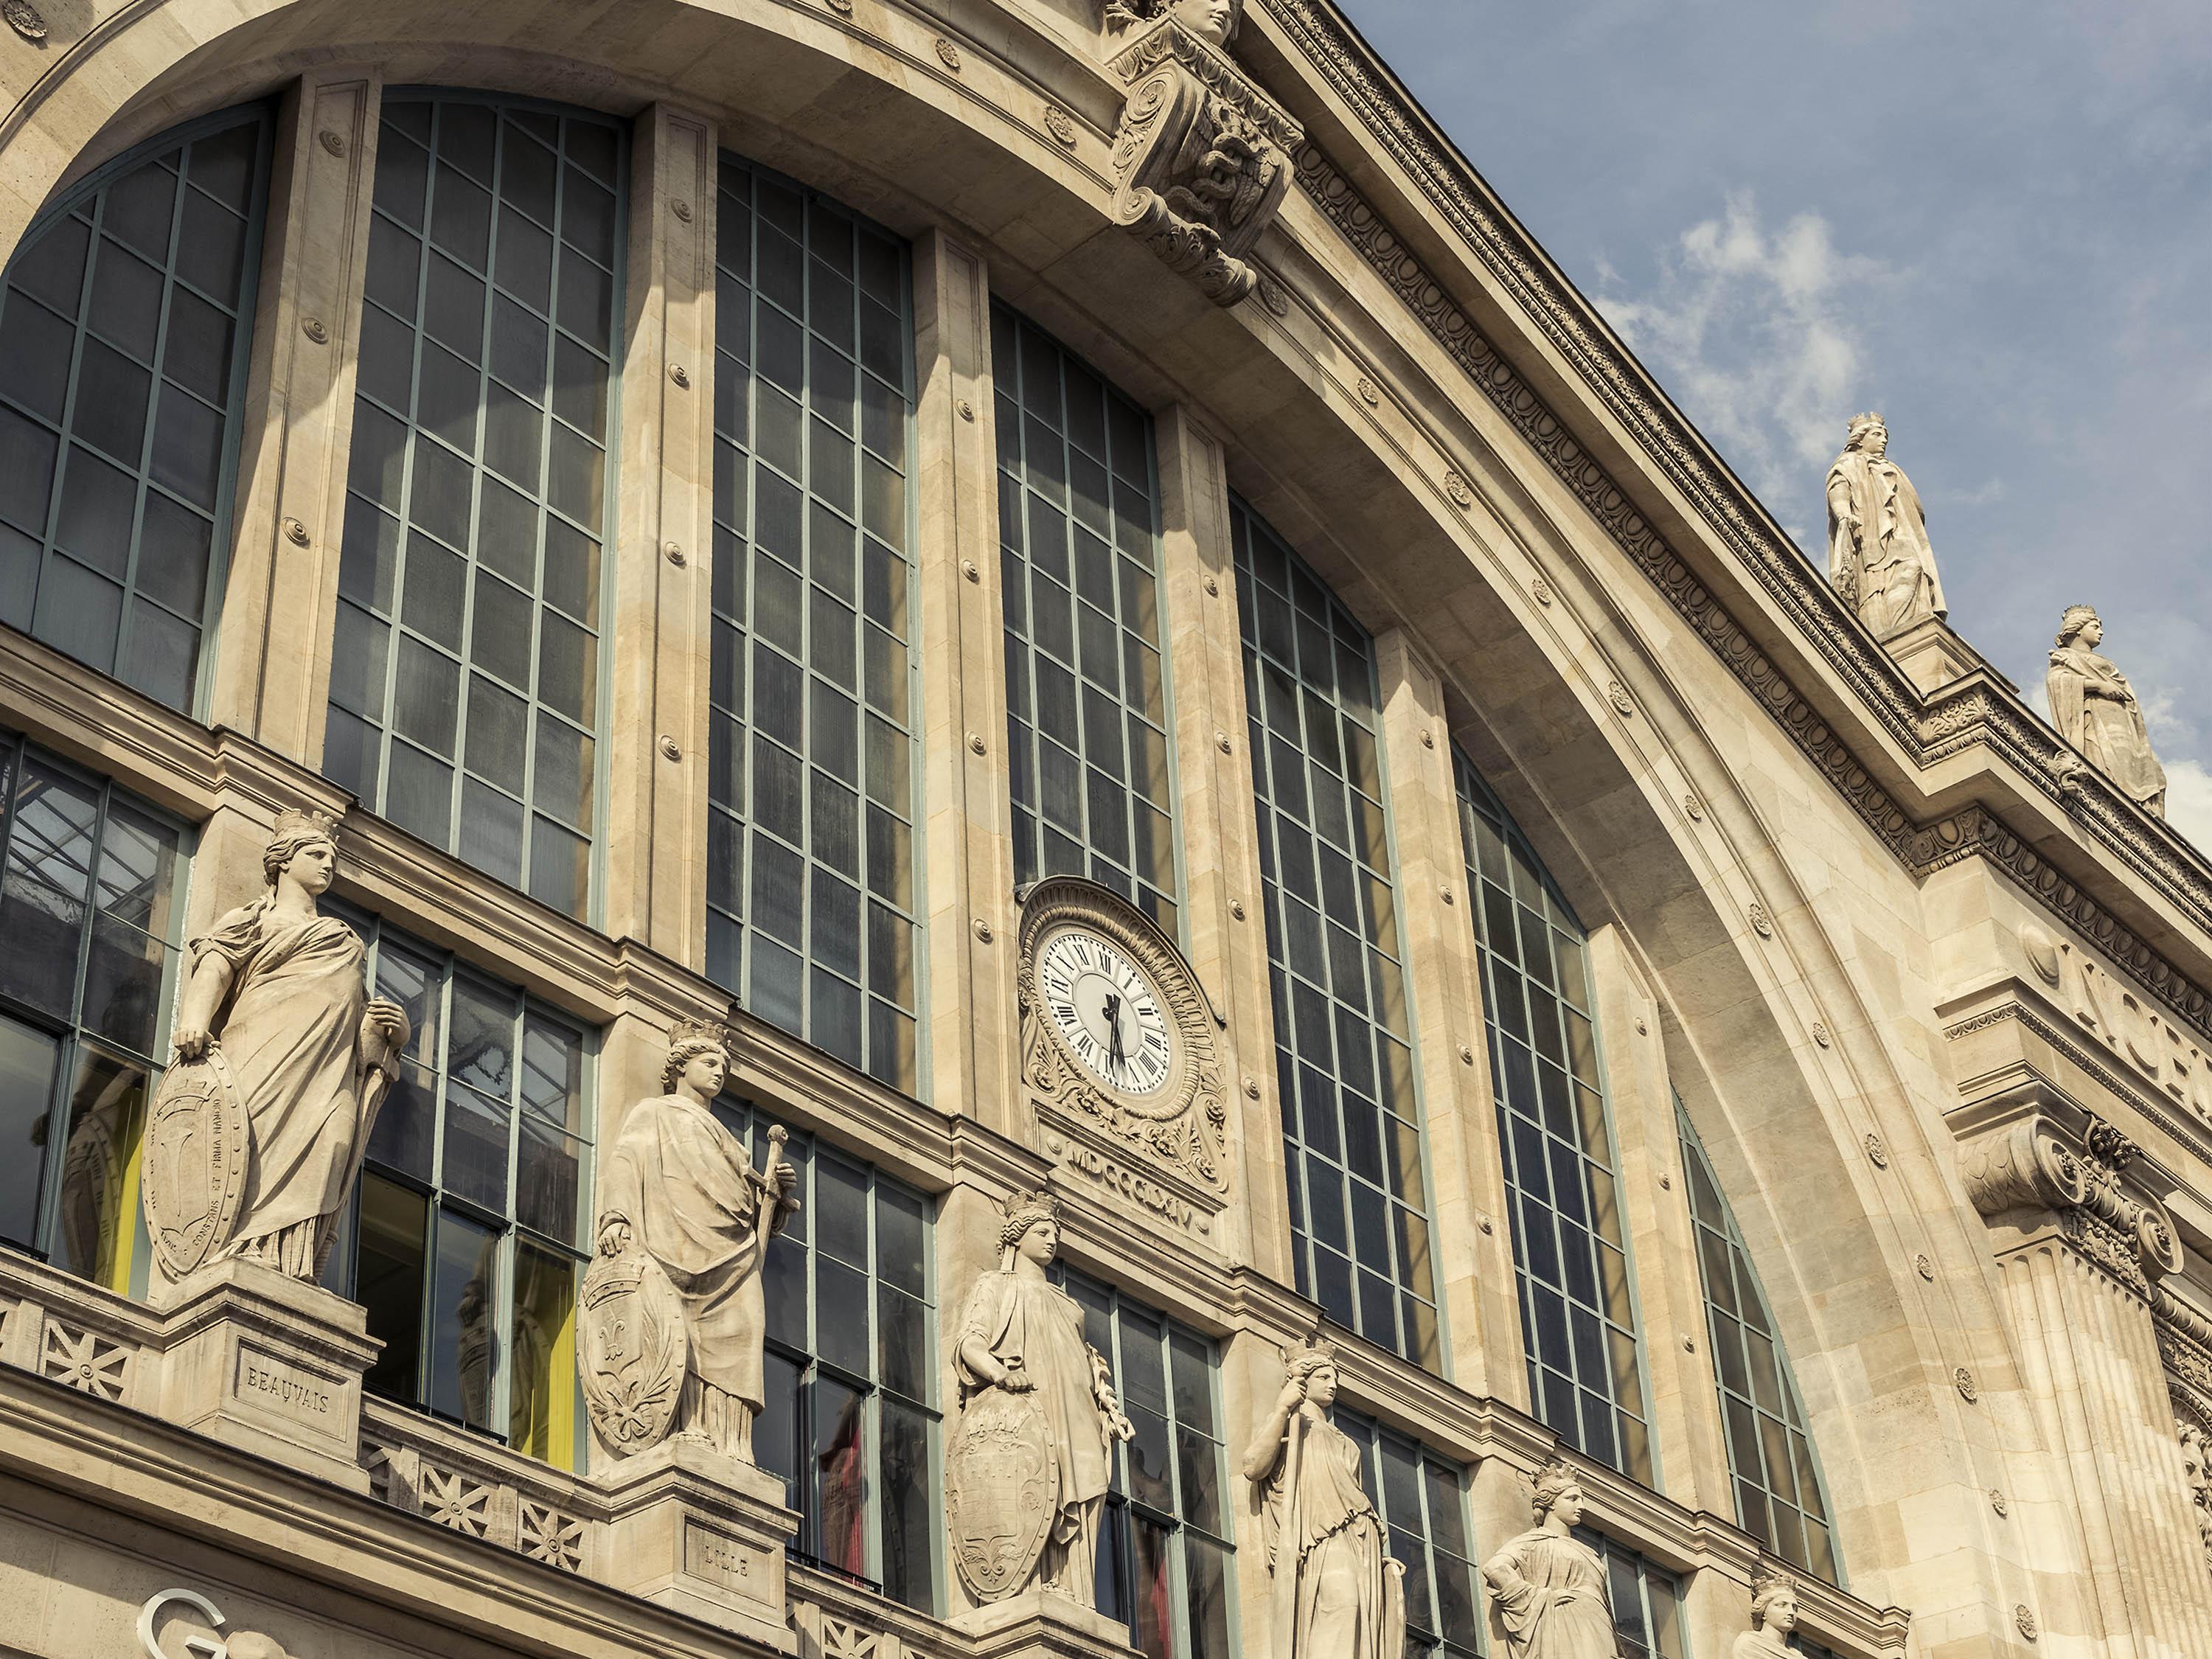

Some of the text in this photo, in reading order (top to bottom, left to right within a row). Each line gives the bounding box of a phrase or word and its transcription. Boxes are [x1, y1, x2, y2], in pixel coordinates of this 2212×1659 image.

[1056, 951, 1075, 975] X
[1073, 944, 1090, 966] XI
[1099, 950, 1112, 975] XII
[1051, 973, 1070, 994] IX
[1123, 977, 1133, 990] I
[1057, 1005, 1077, 1026] VIII
[1138, 1006, 1154, 1017] II
[1077, 1034, 1094, 1057] VII
[1144, 1032, 1162, 1051] III
[1138, 1051, 1158, 1077] IIII
[1066, 1141, 1193, 1228] MDCCCLXIV
[247, 1366, 329, 1413] BEAUVAIS
[705, 1545, 748, 1577] LILLE
